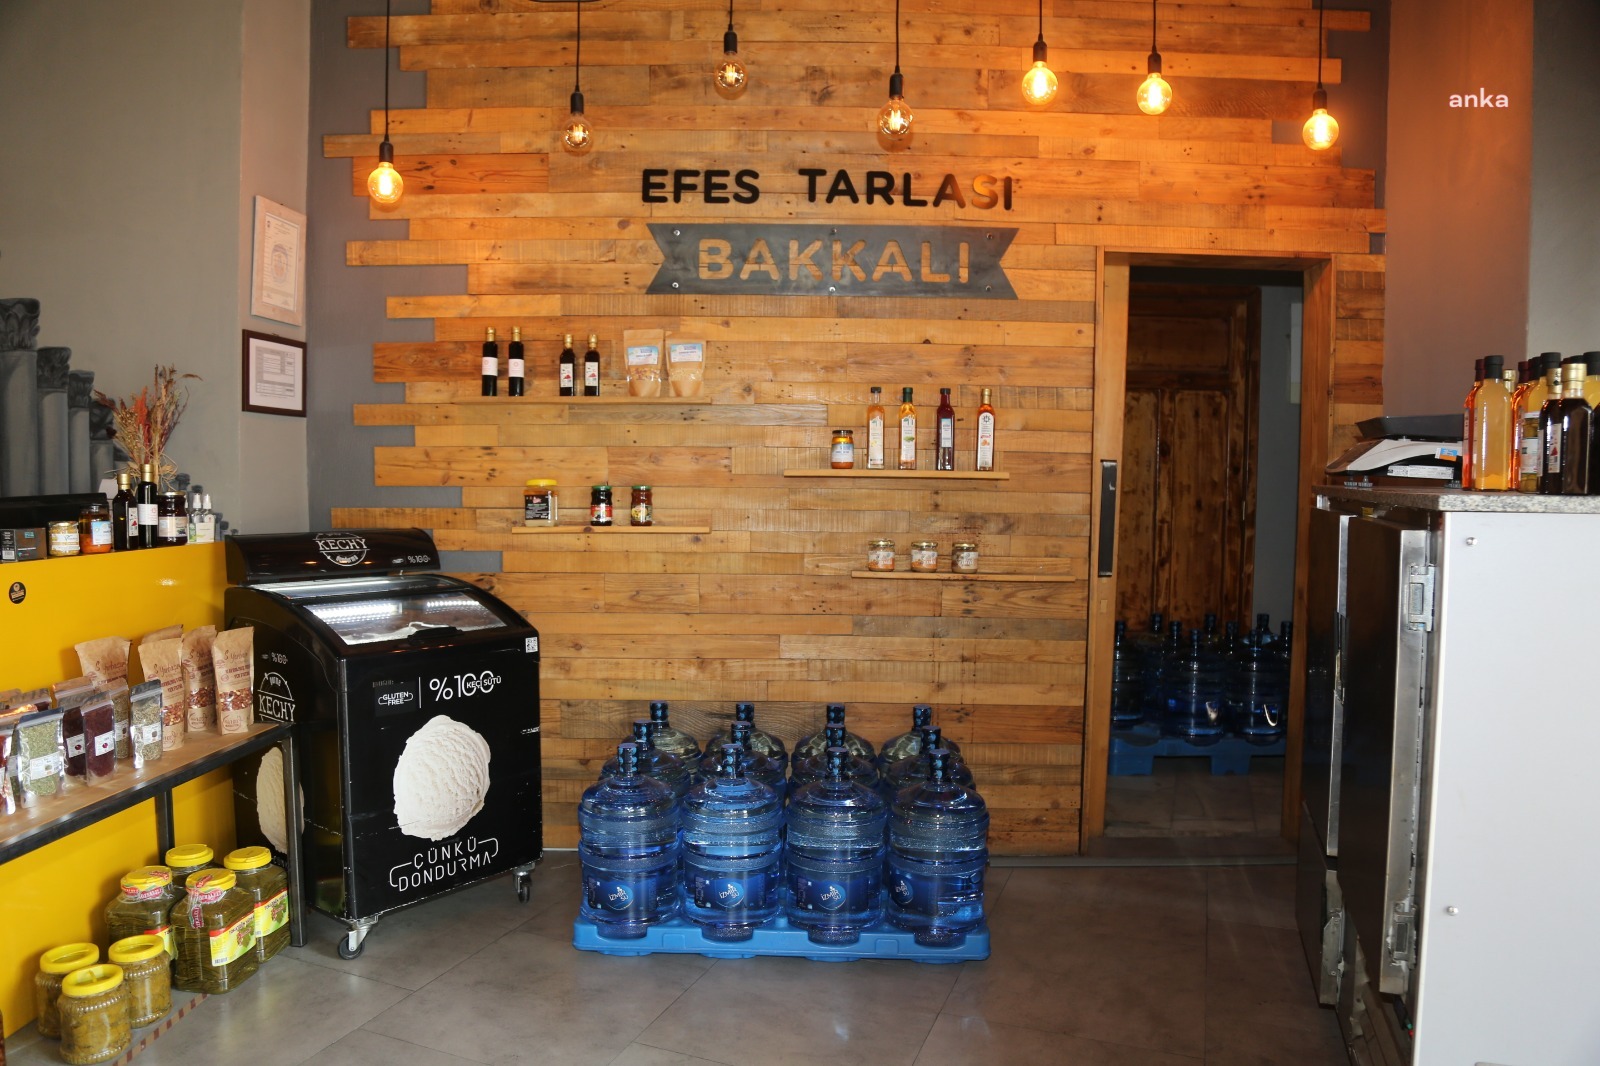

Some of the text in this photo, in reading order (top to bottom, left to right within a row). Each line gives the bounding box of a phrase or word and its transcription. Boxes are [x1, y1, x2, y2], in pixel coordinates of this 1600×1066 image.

[642, 168, 1013, 211] EFES TARLASI
[698, 238, 970, 284] BAKKALI
[315, 539, 368, 551] KECHY
[383, 691, 409, 700] GLUTEN
[429, 670, 494, 702] %100
[483, 676, 502, 686] SÜTÜ
[258, 694, 296, 722] KECHY
[414, 836, 476, 869] ÇÜNKÜ
[399, 851, 491, 892] DONDURMA
